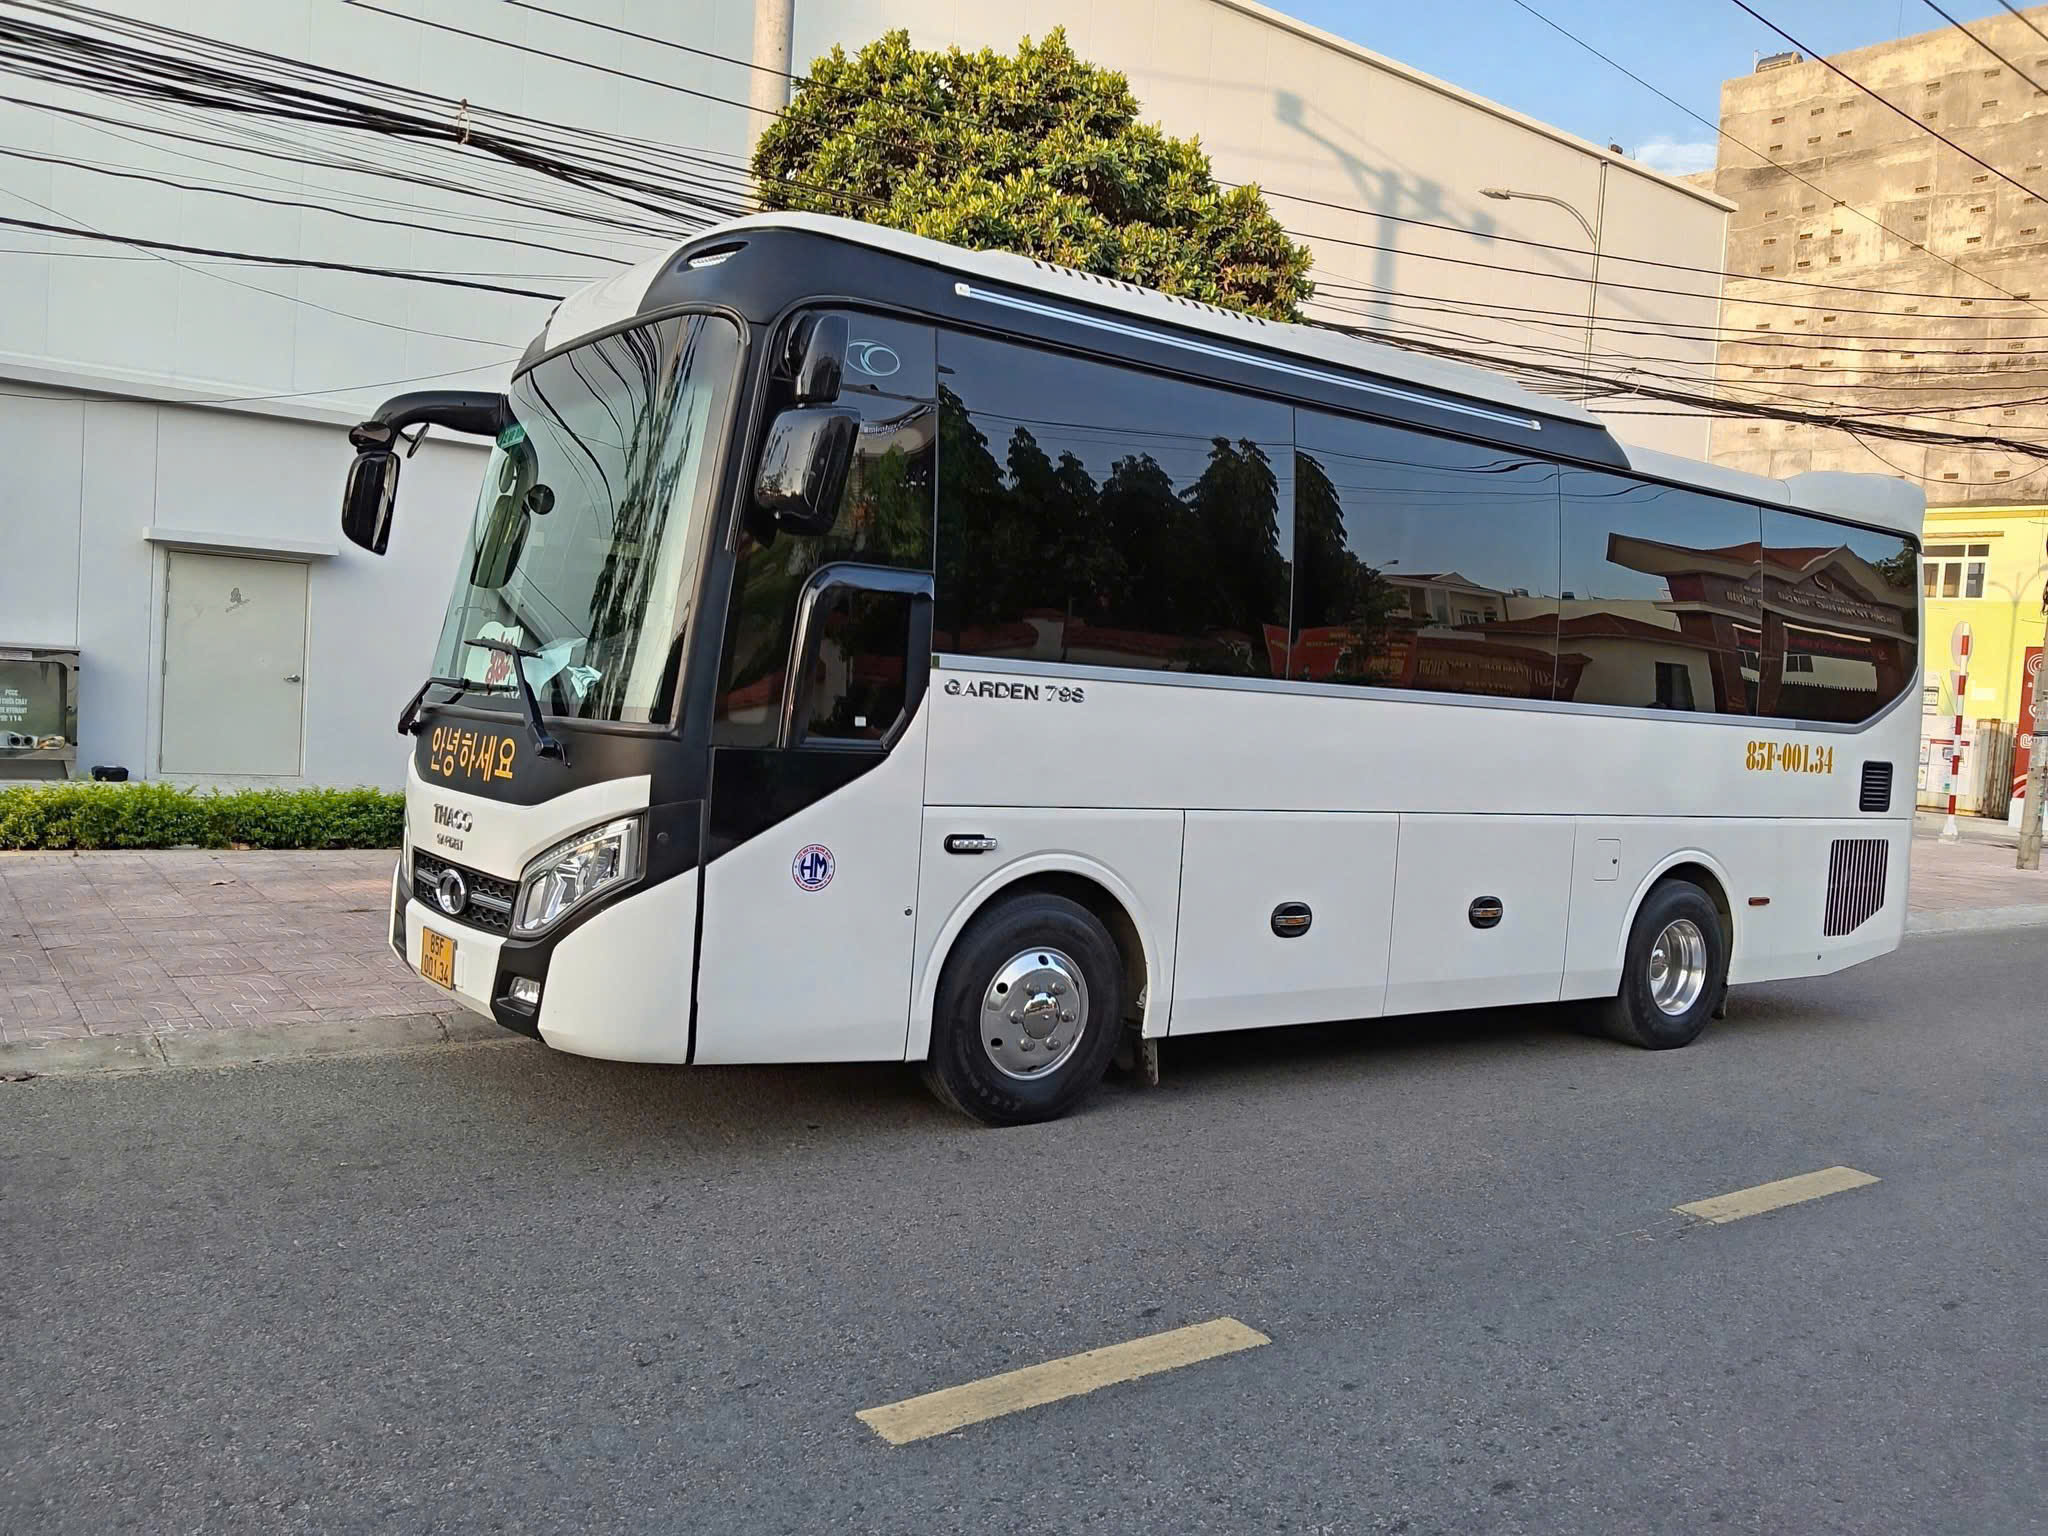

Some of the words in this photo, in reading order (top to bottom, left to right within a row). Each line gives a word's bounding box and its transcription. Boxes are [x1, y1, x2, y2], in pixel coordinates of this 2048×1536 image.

[944, 679, 1039, 701] GARDEN
[1045, 685, 1085, 703] 79S
[430, 726, 516, 782] 안녕하세요
[1746, 741, 1834, 774] 85F-001.34
[433, 804, 473, 832] THACO
[801, 853, 828, 879] HM
[430, 933, 445, 956] 85F
[424, 953, 449, 985] 001.34
